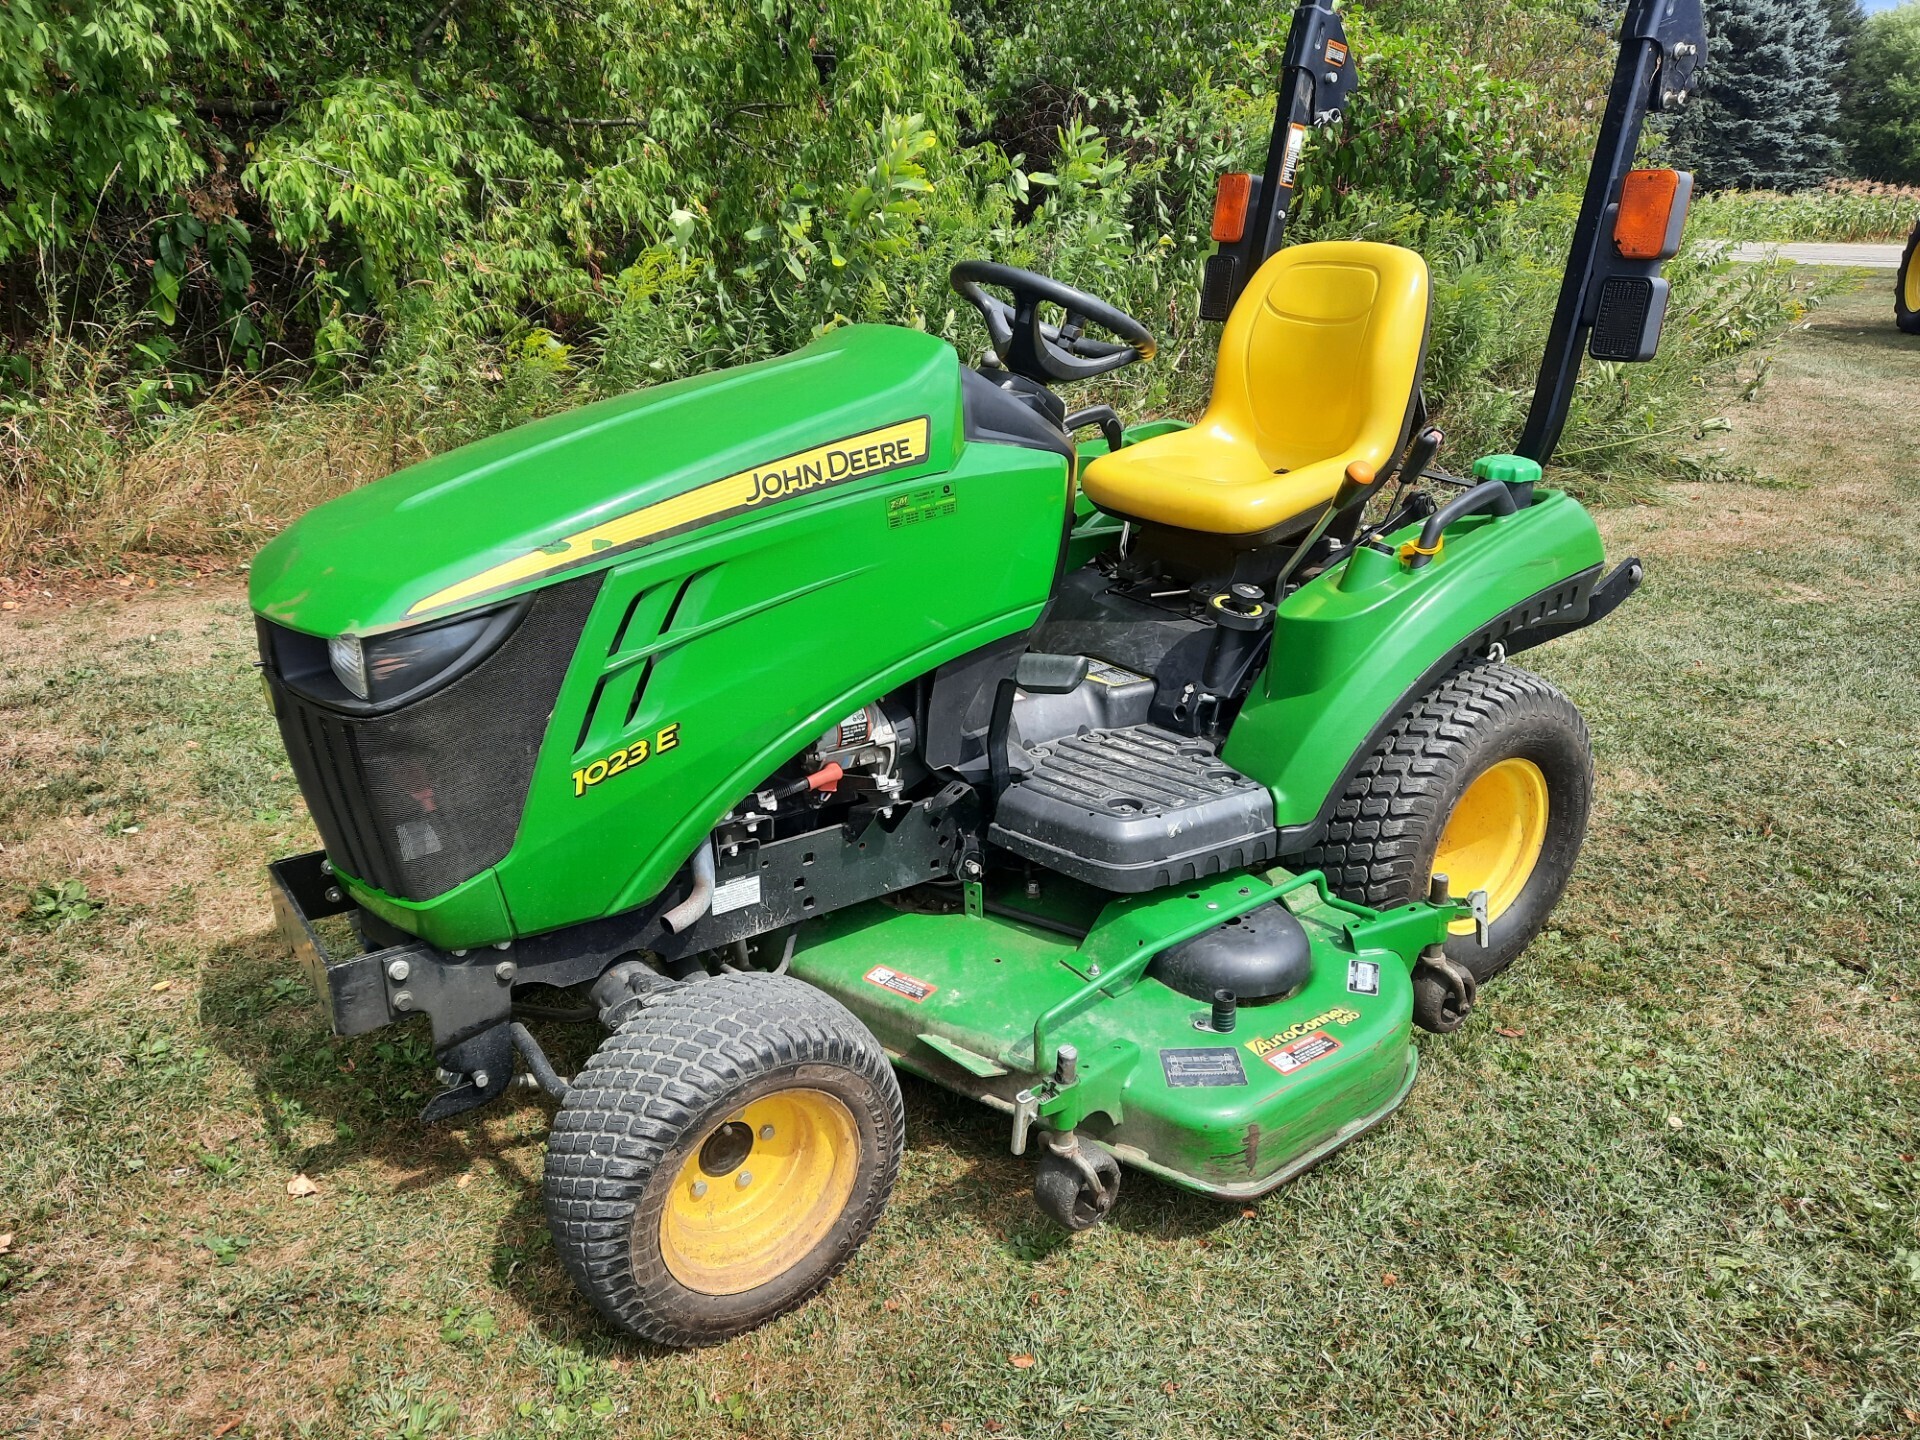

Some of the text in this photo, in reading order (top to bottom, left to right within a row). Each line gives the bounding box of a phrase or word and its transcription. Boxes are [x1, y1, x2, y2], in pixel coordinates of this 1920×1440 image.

[746, 438, 912, 502] JOHN DEERE
[572, 722, 680, 798] 1023 E
[865, 1098, 887, 1152] MULTI
